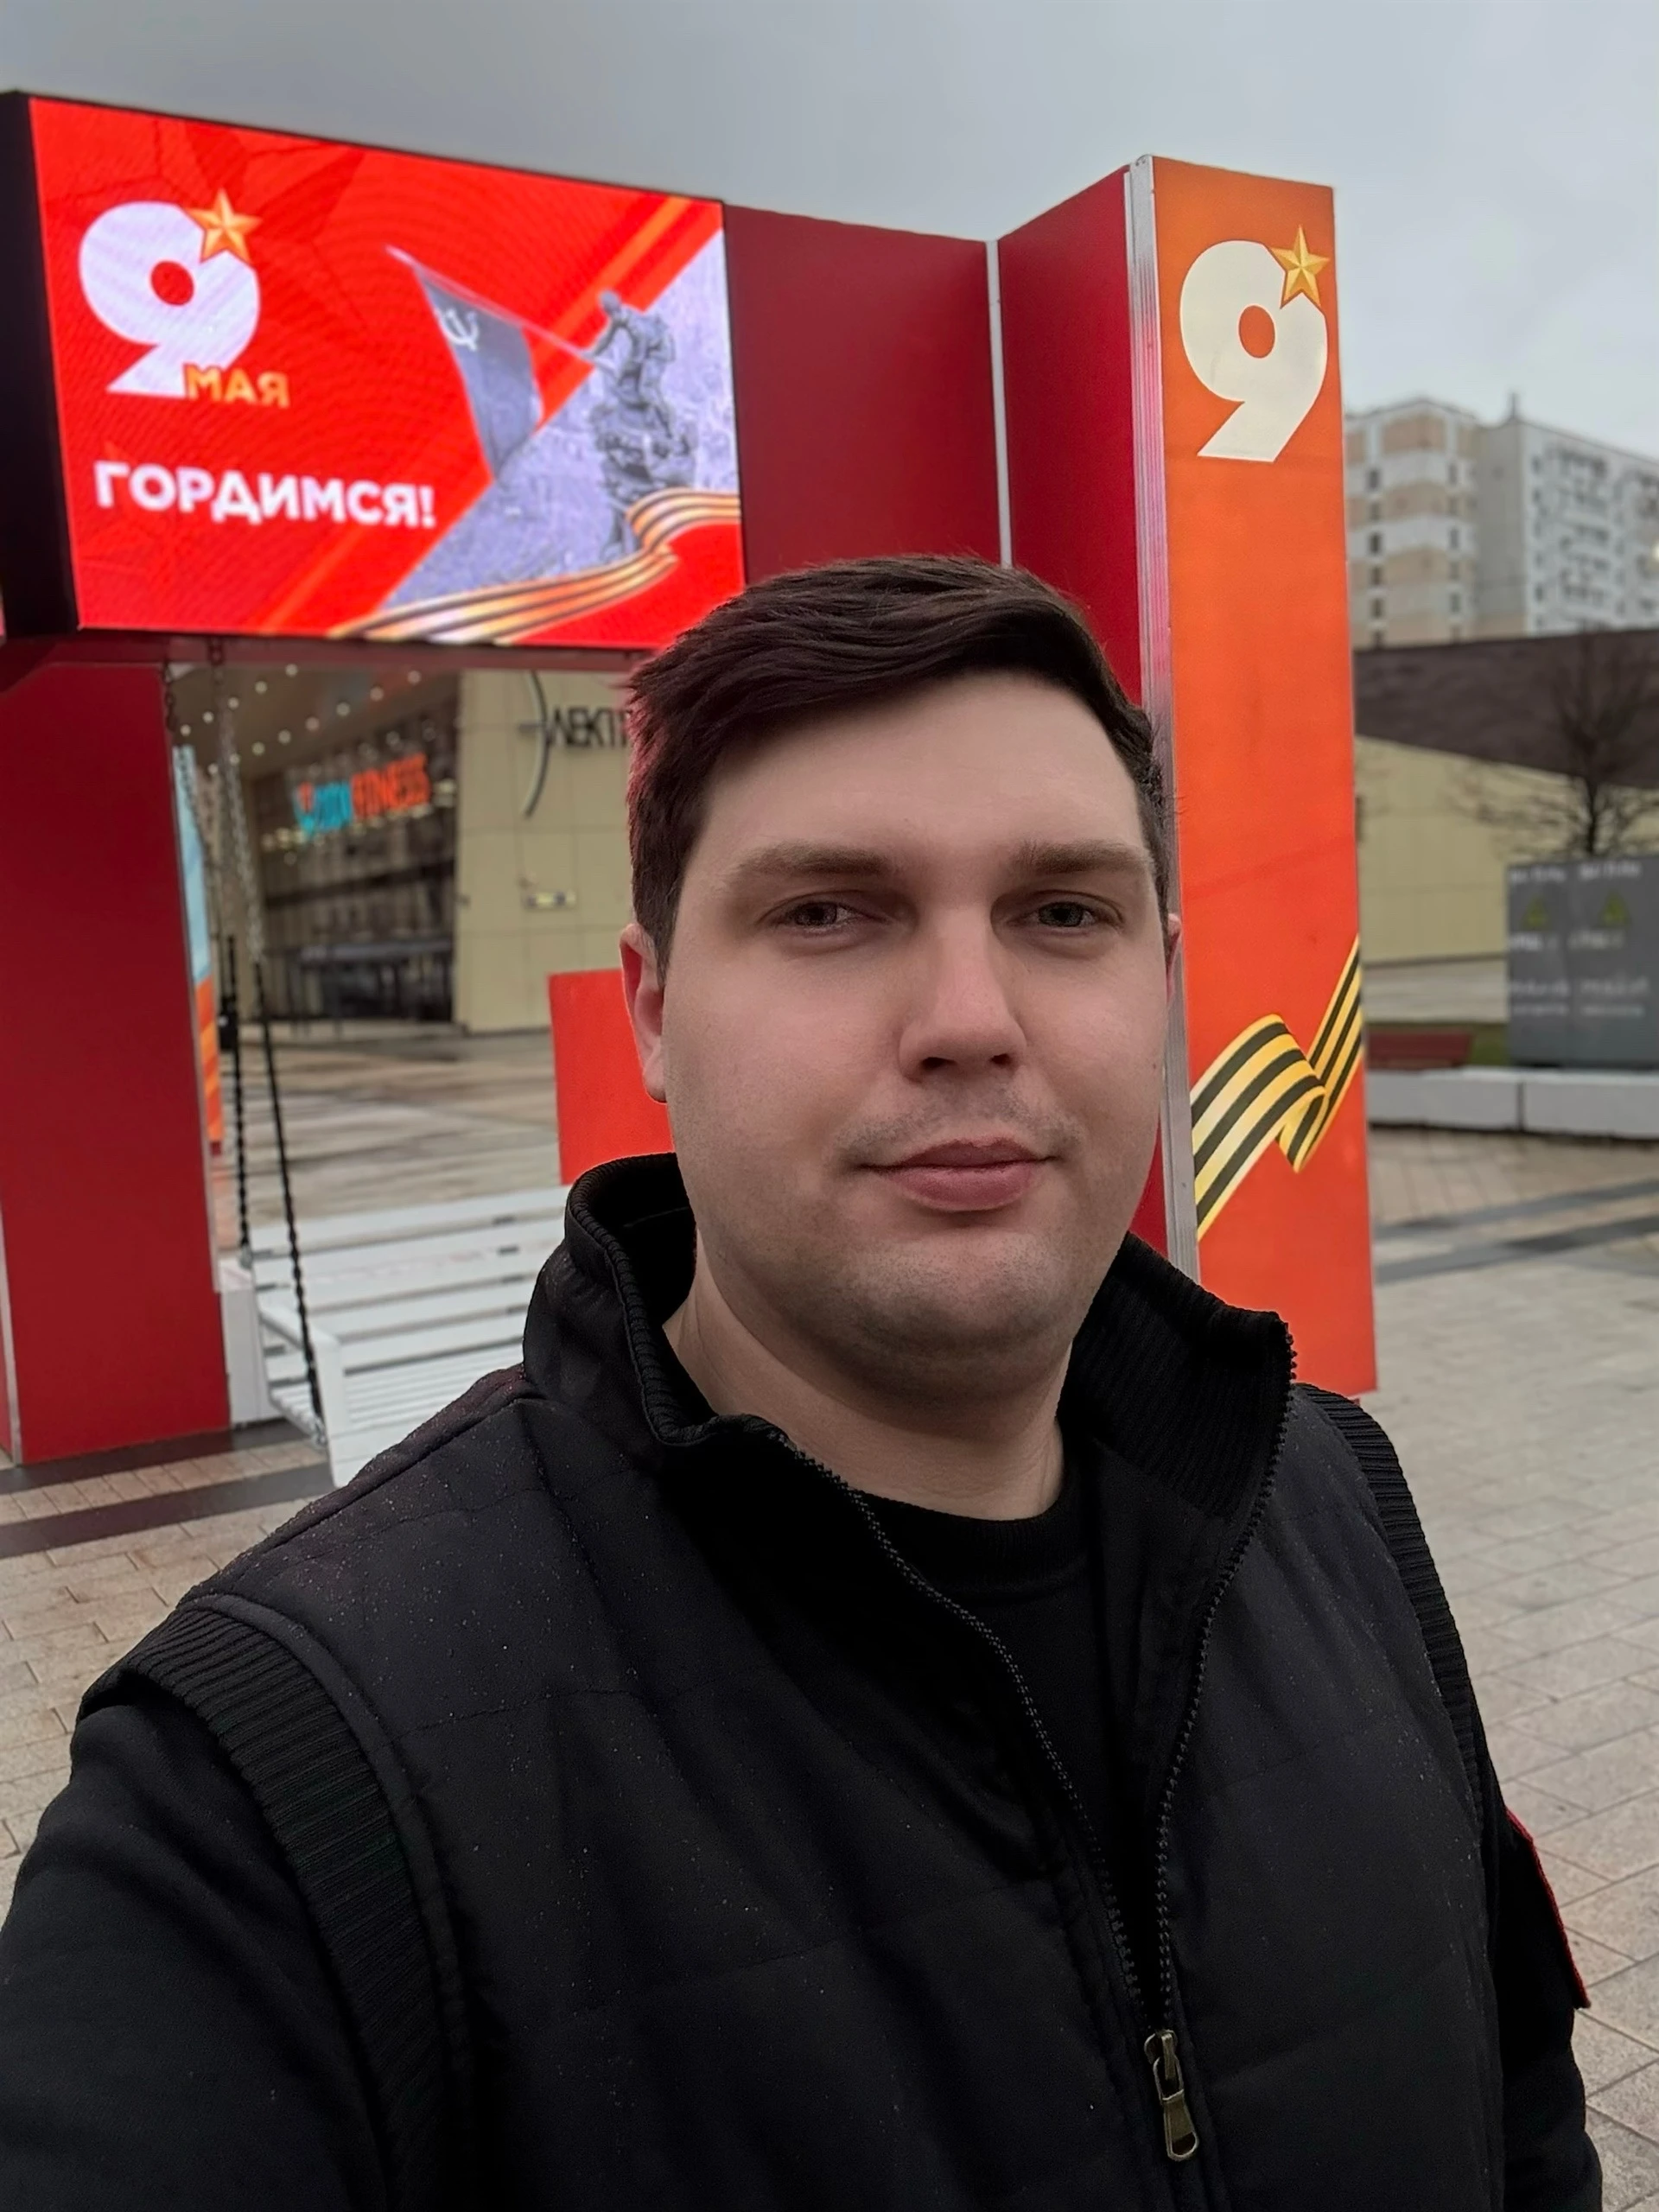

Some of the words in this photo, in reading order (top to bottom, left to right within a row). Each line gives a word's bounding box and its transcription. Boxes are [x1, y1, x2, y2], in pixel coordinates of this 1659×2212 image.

[79, 200, 261, 397] 9
[184, 363, 290, 409] МАЯ
[1179, 240, 1328, 462] 9
[94, 460, 436, 528] ГОРДИМСЯ!
